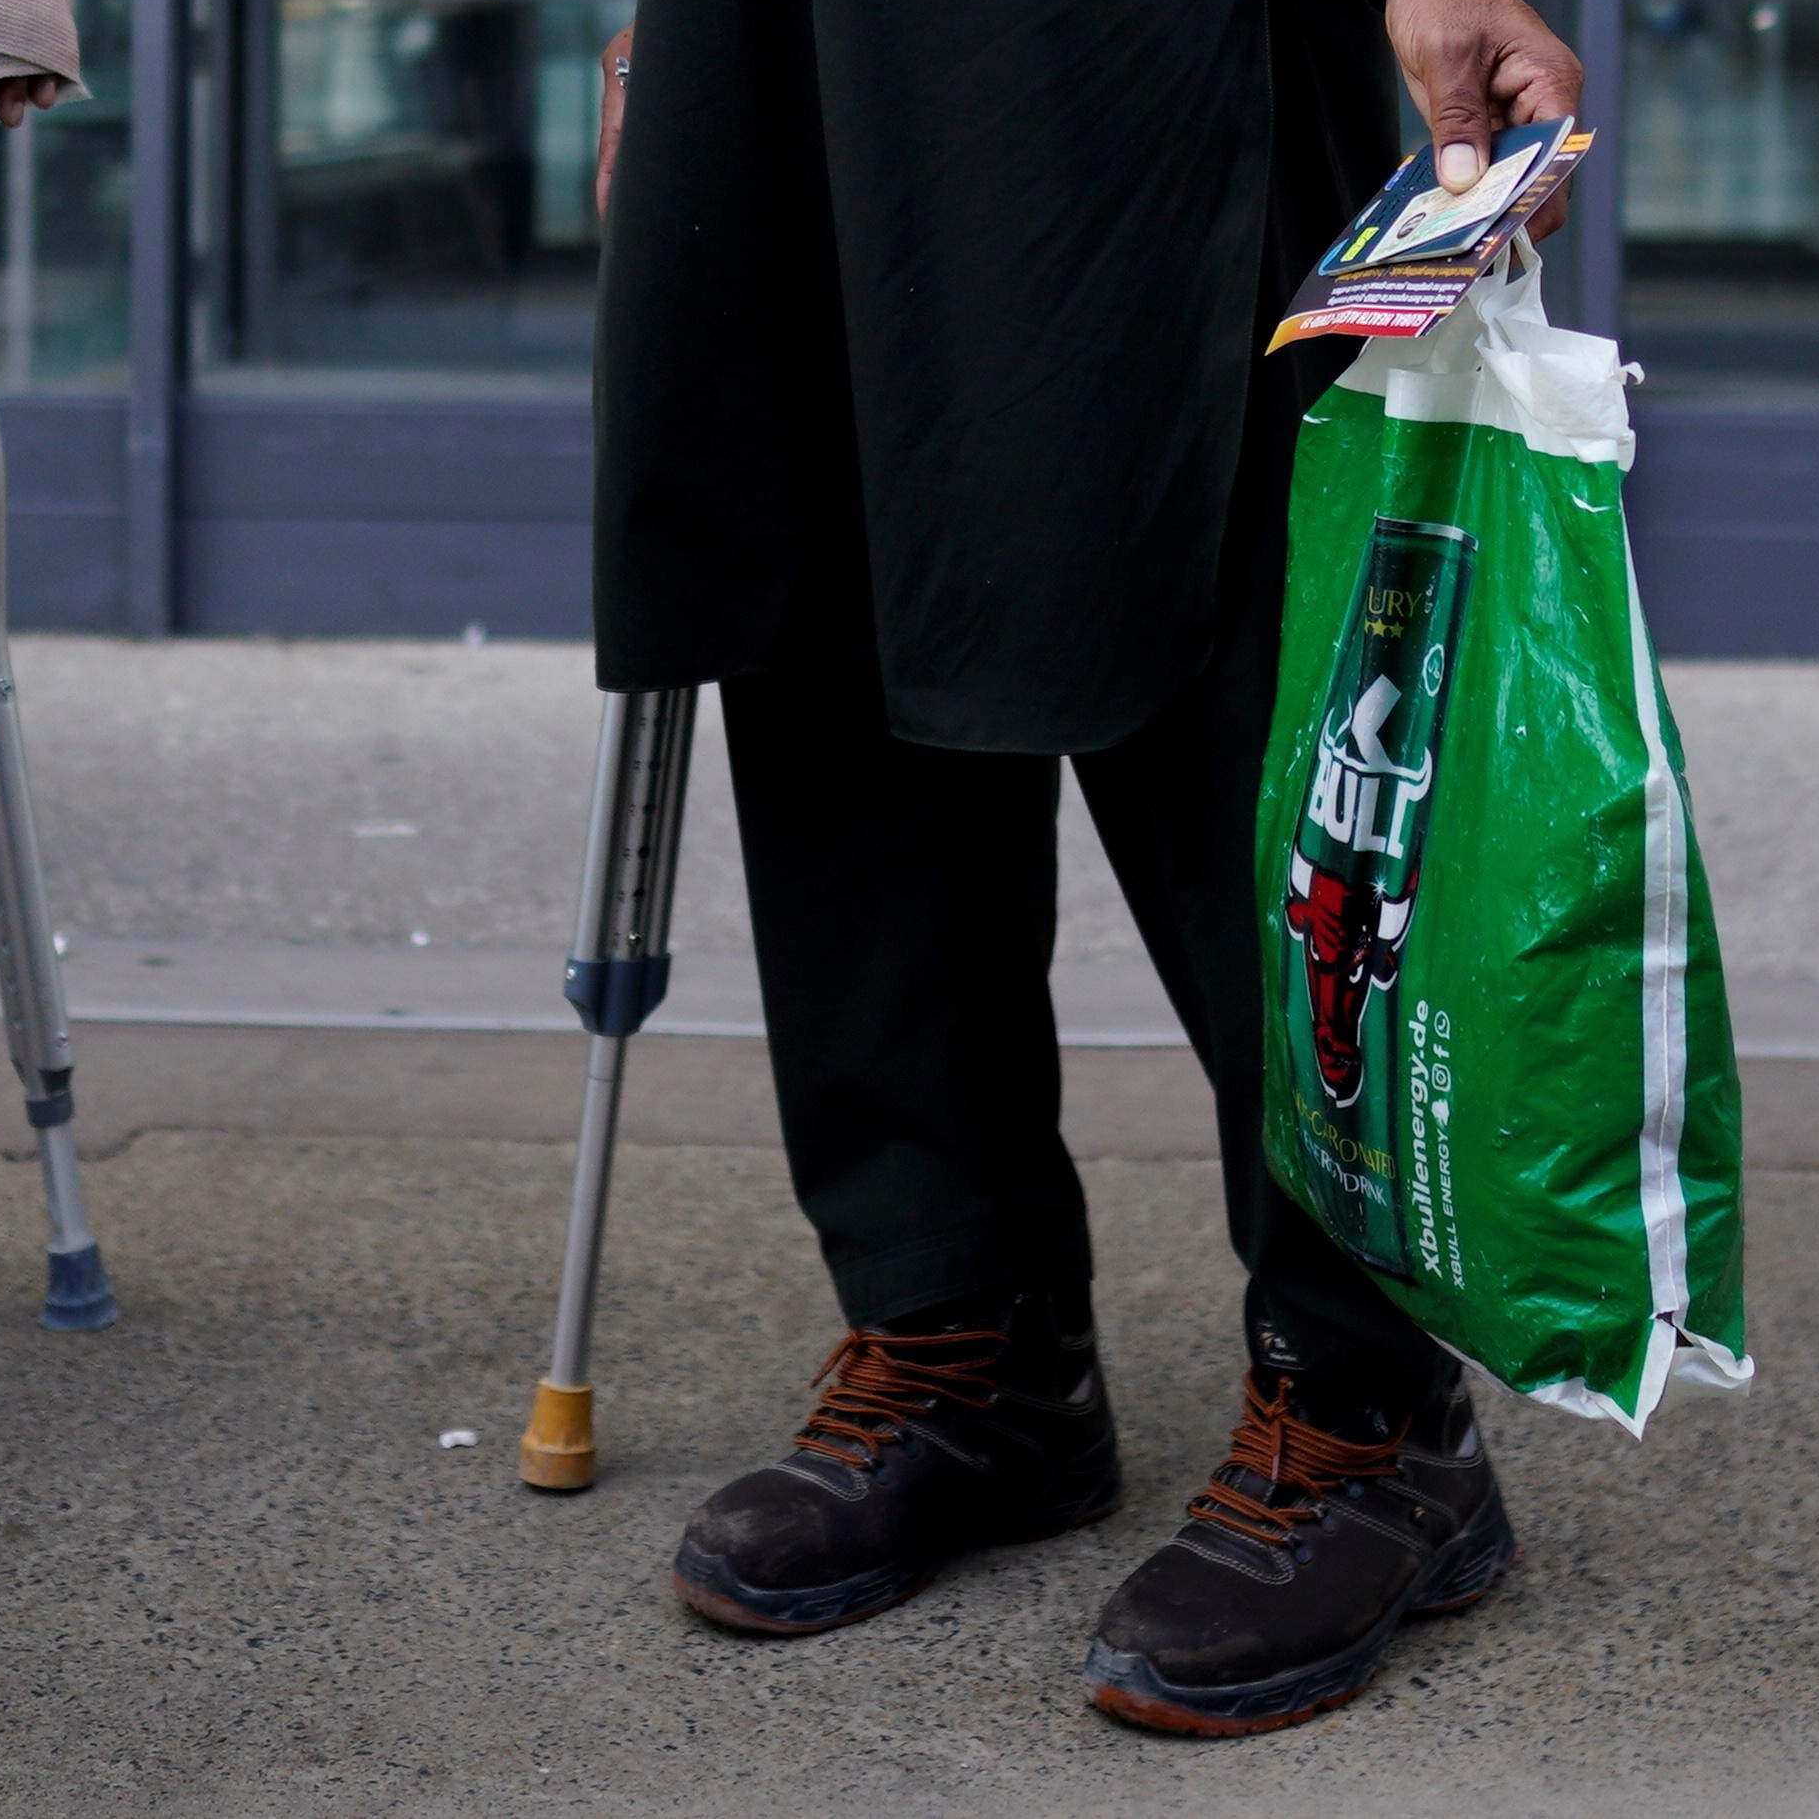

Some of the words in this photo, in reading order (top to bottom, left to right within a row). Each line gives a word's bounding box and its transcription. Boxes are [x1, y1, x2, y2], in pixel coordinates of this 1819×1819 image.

[1366, 585, 1423, 617] URY
[1307, 756, 1428, 859] BULL
[1437, 1129, 1454, 1217] ENERGY
[1446, 1223, 1466, 1290] XBULL
